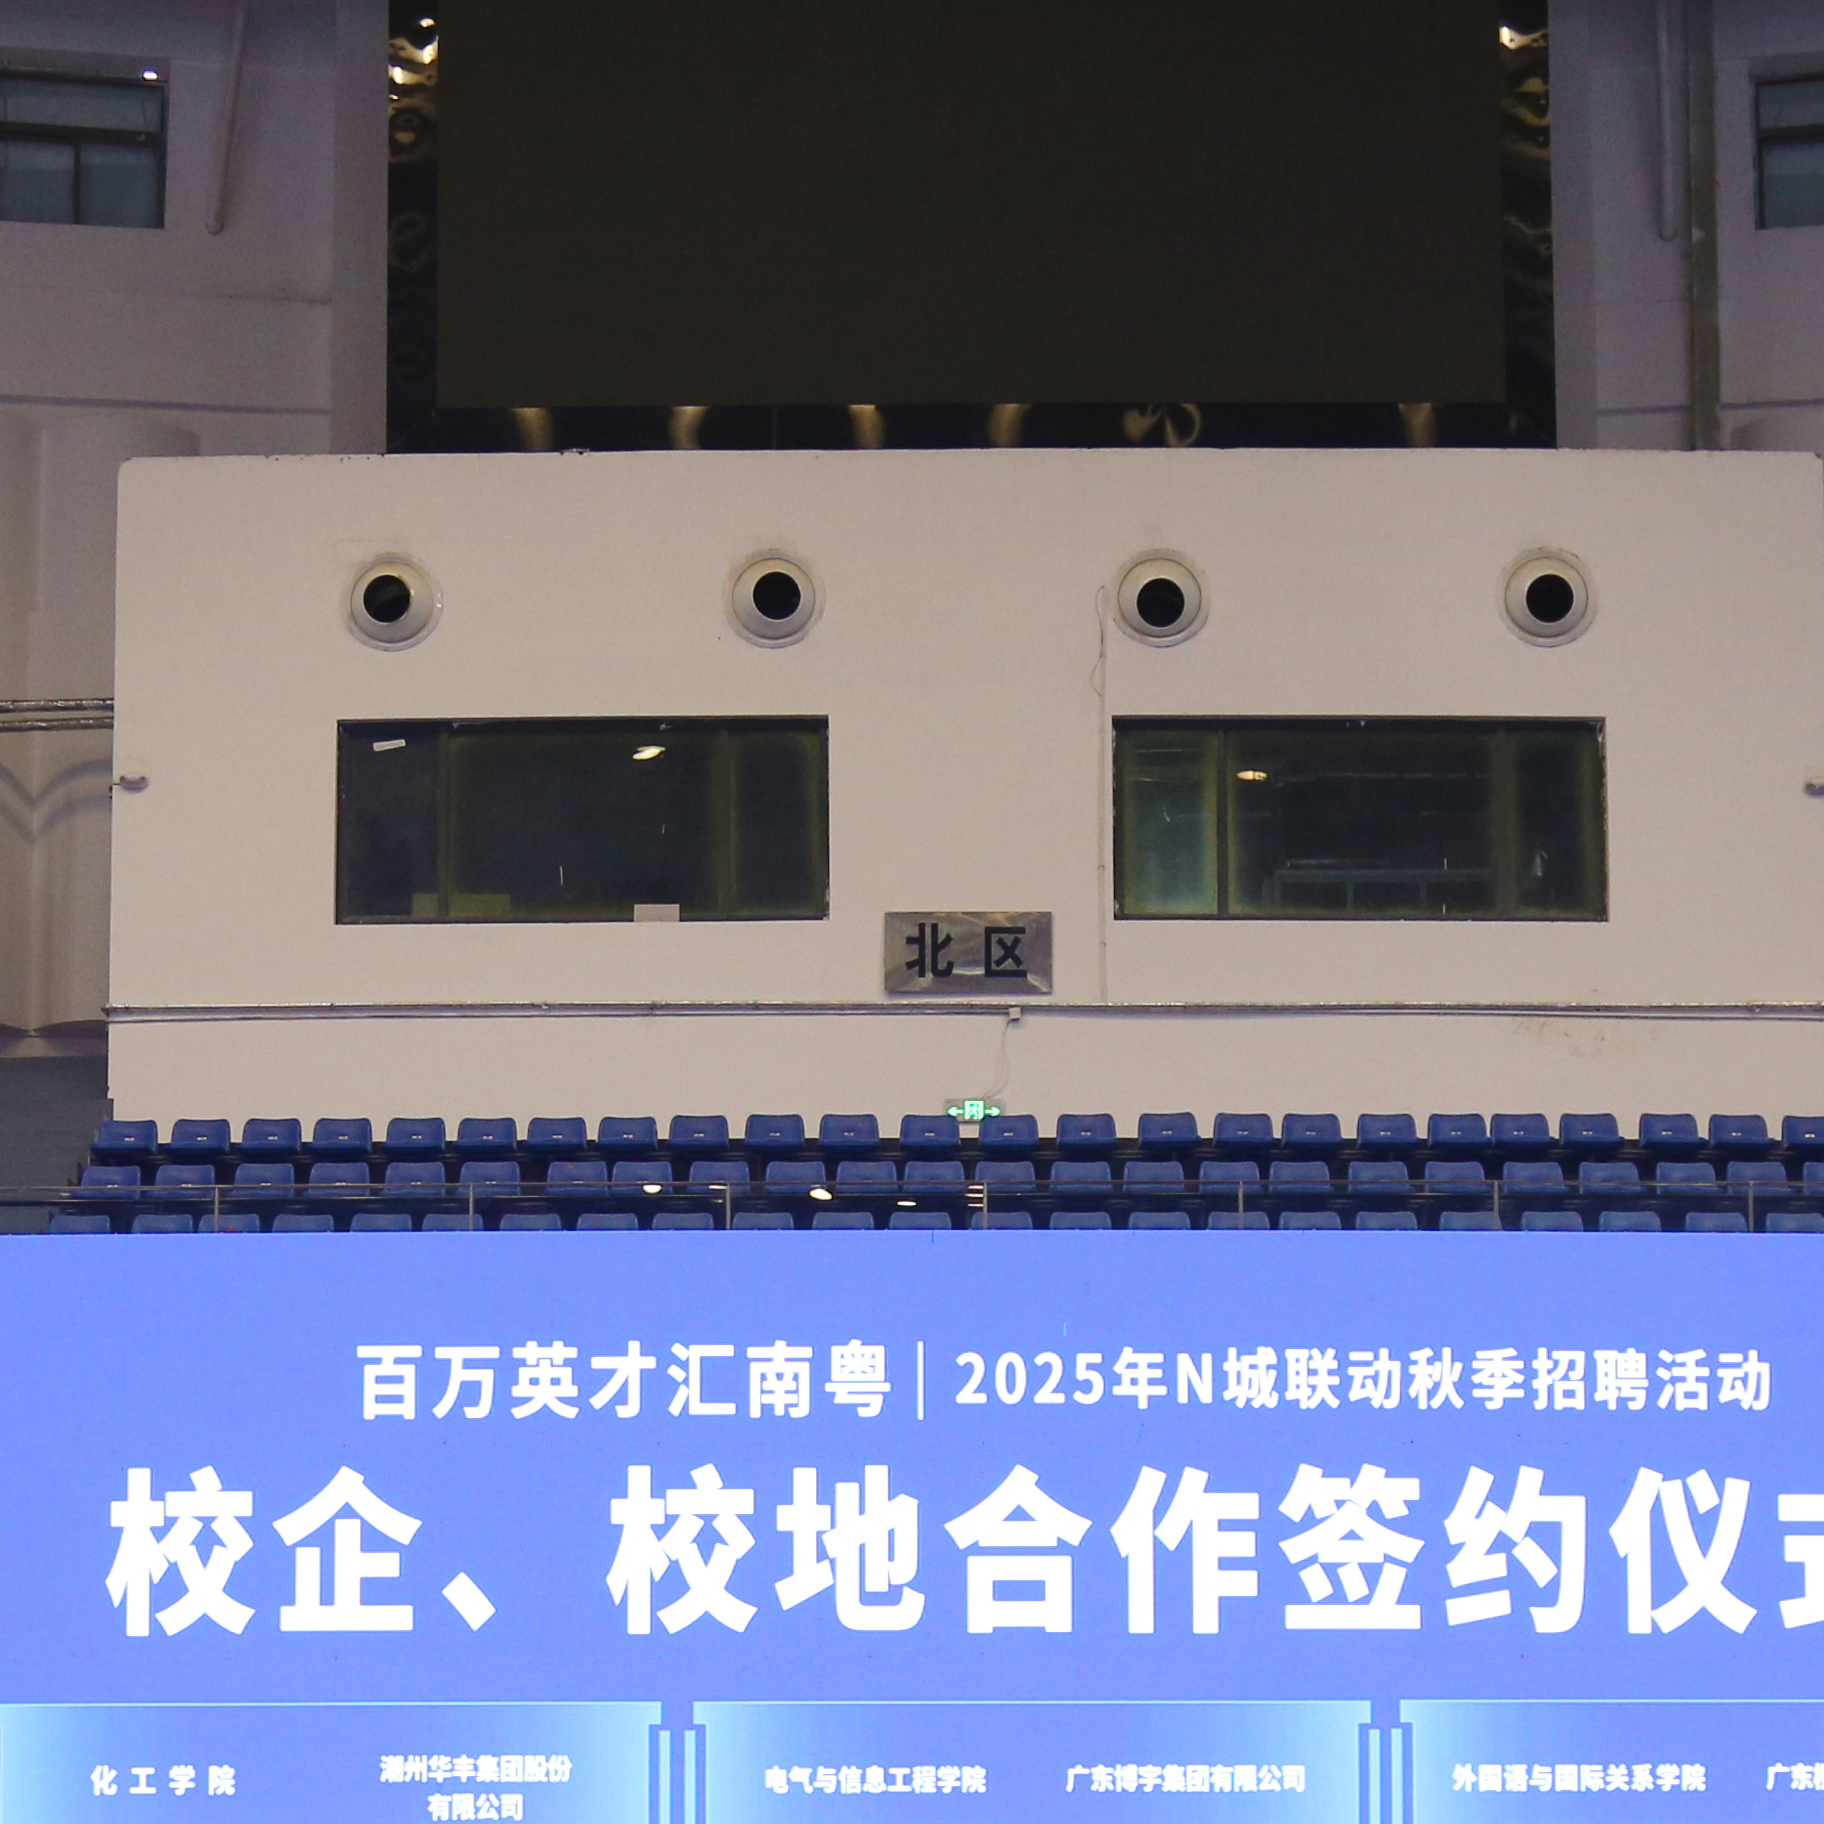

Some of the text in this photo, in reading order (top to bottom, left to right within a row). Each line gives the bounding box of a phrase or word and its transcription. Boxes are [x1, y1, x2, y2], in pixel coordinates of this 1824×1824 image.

[905, 922, 1027, 978] 北区
[358, 1340, 1770, 1420] 百万英才汇南粤 2025年N城联动秋季招聘活动
[90, 1764, 236, 1797] 化工学院
[380, 1754, 573, 1783] 潮州华丰集团股份
[765, 1765, 987, 1794] 电气与信息工程学院
[1066, 1764, 1306, 1793] 广东博宇集团有限公司
[1452, 1763, 1707, 1792] 外国语与国际关系学院
[427, 1793, 523, 1821] 有限公司
